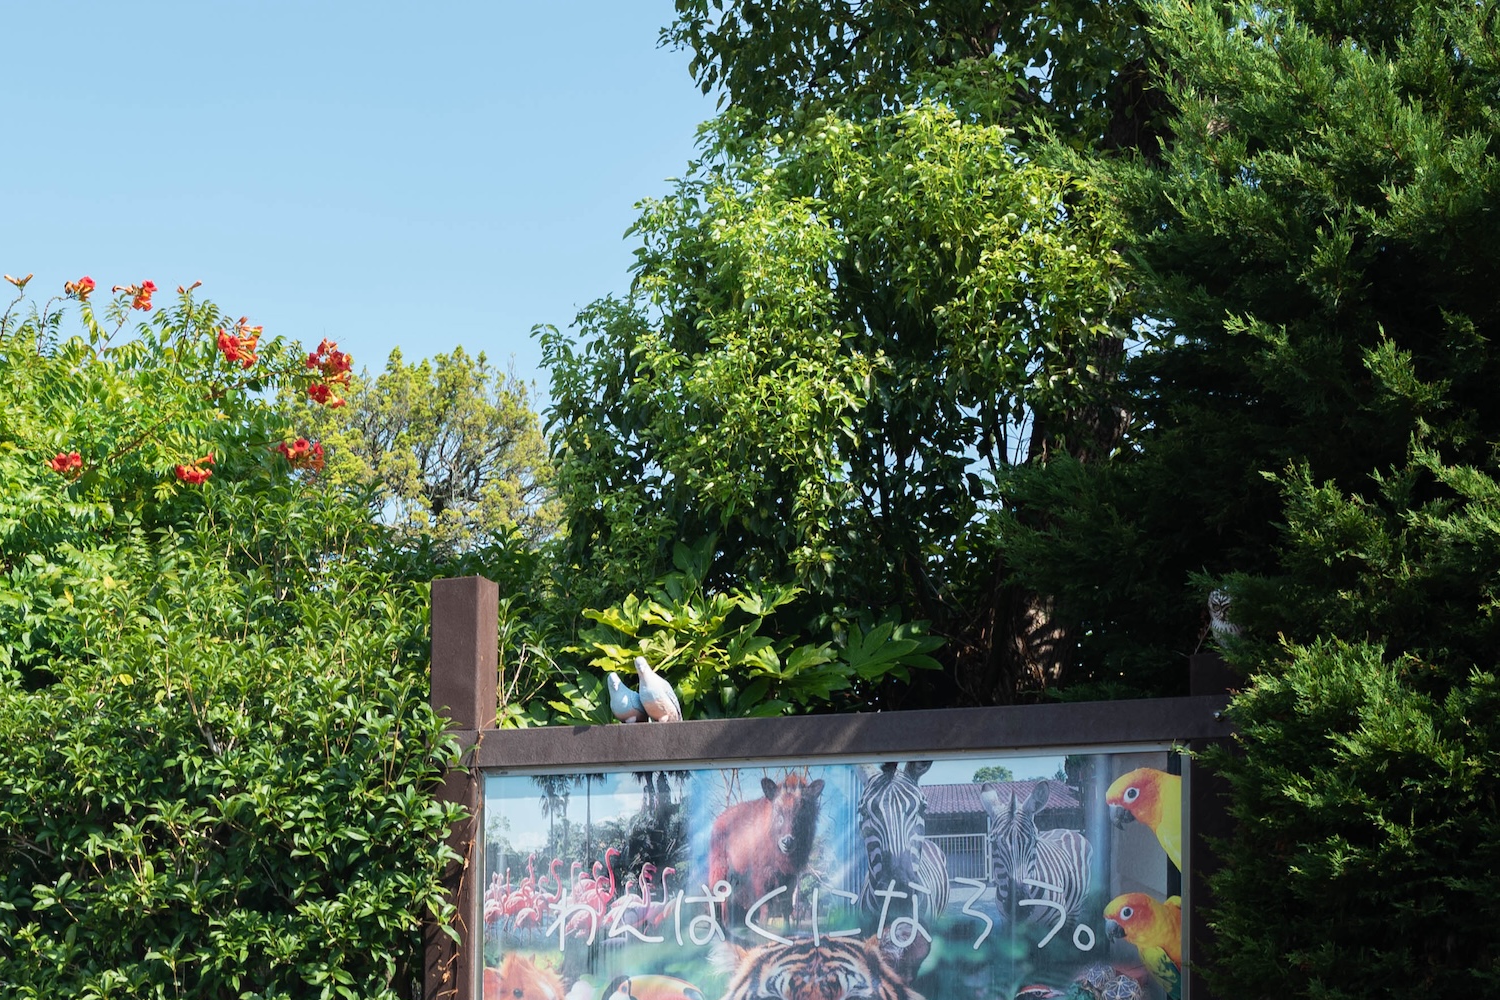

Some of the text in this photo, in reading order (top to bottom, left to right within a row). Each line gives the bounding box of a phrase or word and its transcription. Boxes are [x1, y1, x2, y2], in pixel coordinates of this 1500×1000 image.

[545, 878, 1096, 952] わんぱくになろう。
